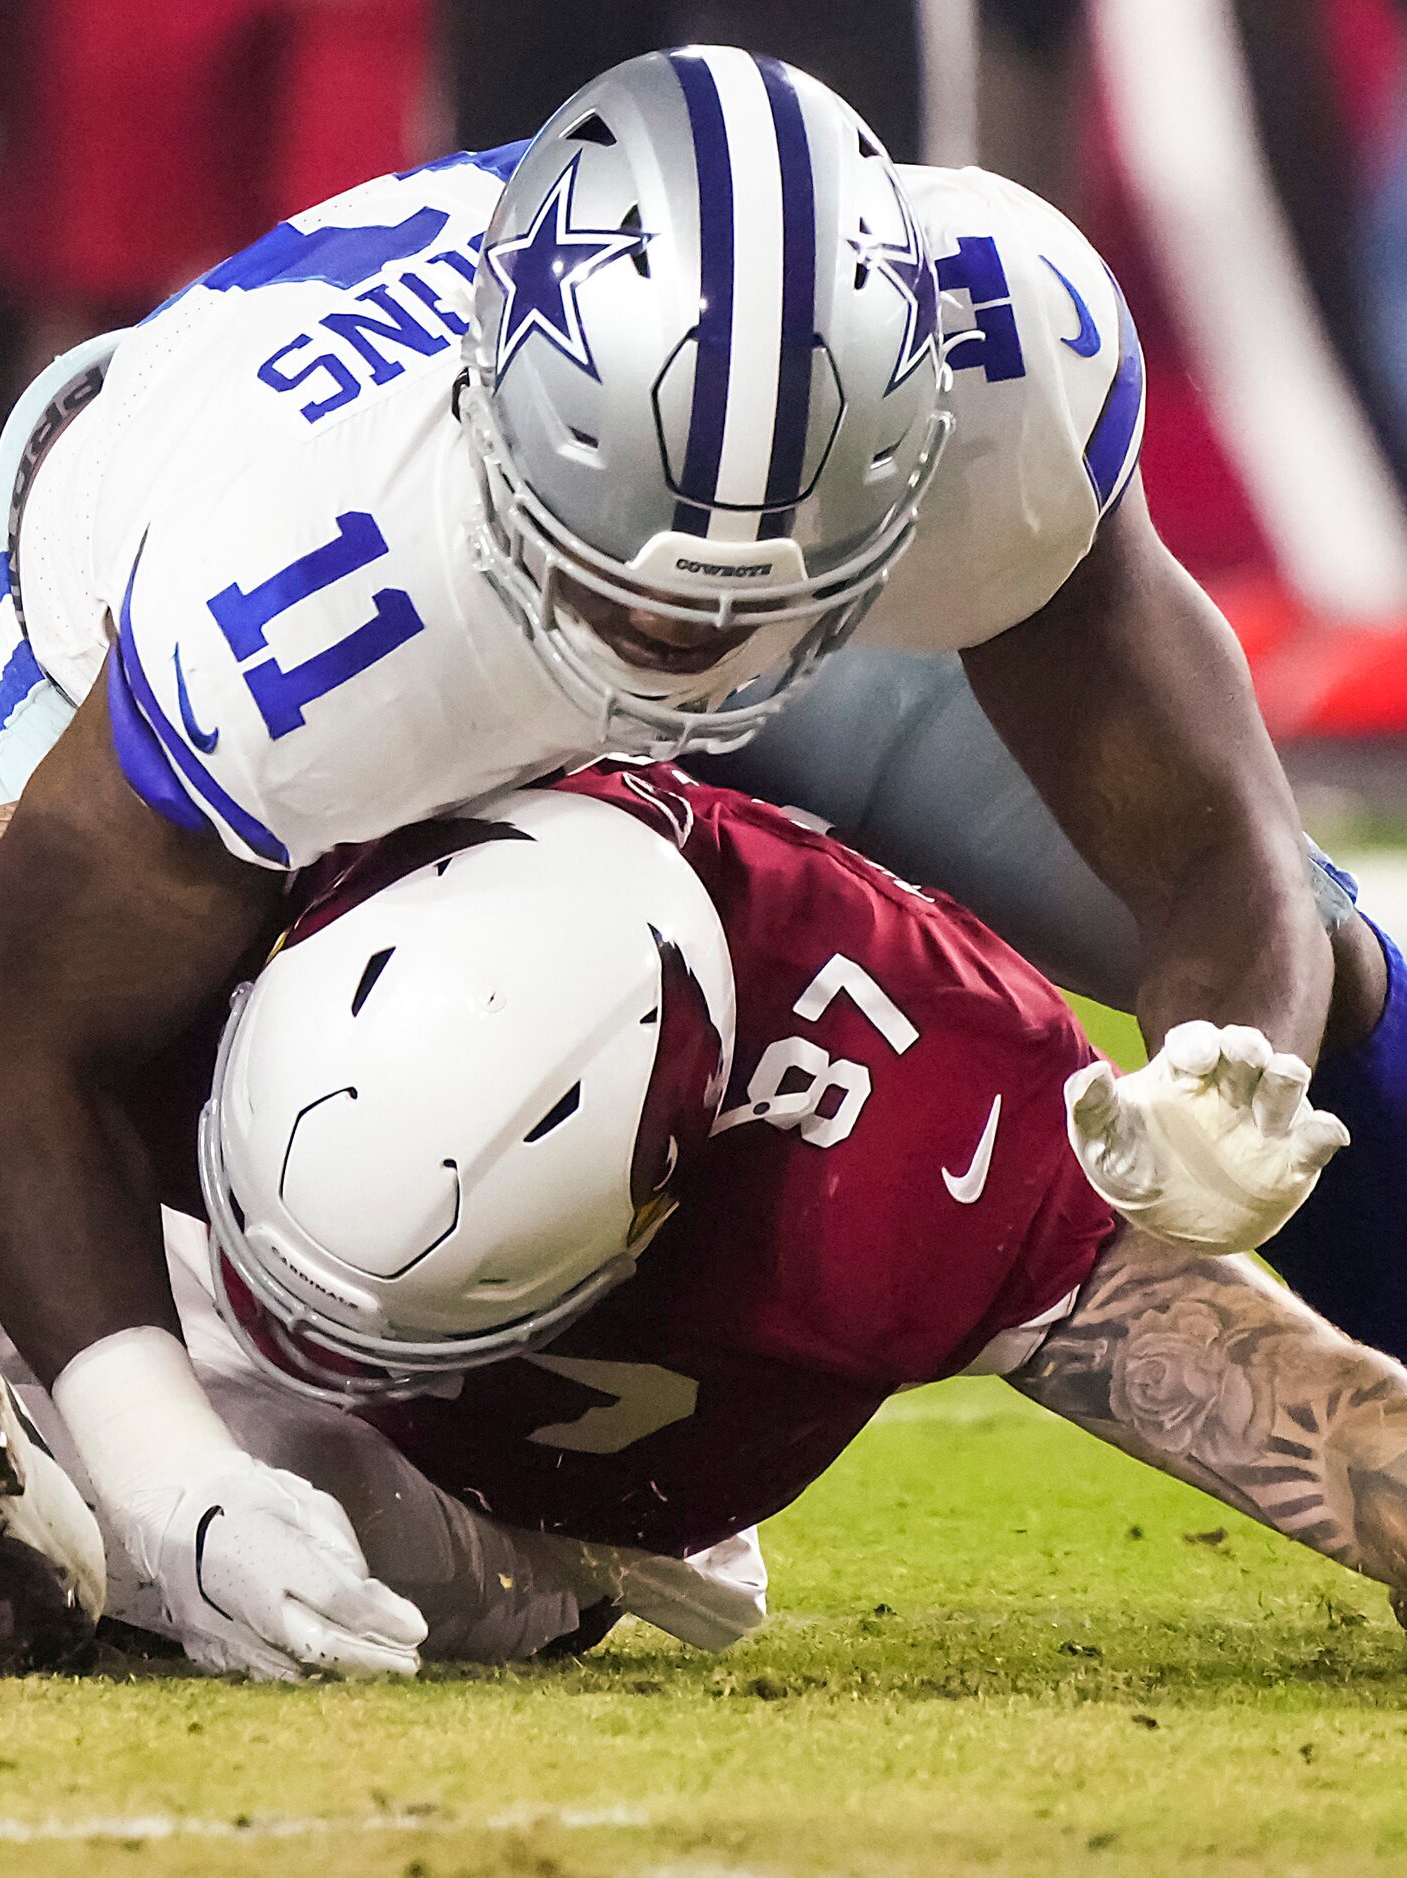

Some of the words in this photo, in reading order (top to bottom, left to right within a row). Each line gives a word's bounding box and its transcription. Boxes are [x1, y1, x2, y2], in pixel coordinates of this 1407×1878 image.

[206, 511, 425, 741] 11
[676, 558, 773, 578] COWBOYS
[746, 952, 920, 1149] 87
